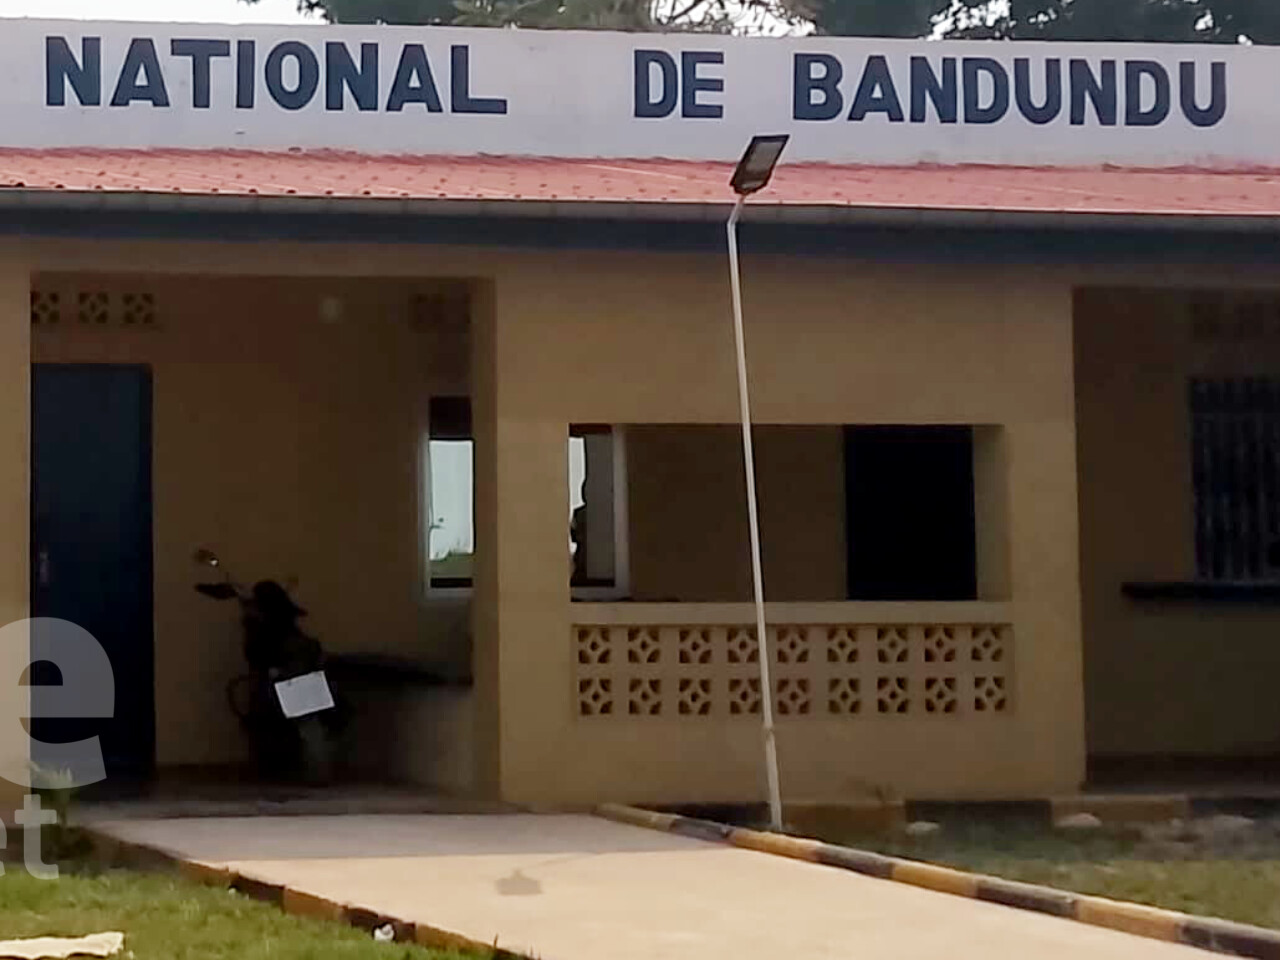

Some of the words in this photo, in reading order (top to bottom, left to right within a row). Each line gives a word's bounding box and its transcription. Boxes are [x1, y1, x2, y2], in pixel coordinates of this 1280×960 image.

[45, 36, 508, 115] NATIONAL
[633, 49, 725, 119] DE
[792, 52, 1228, 128] BANDUNDU
